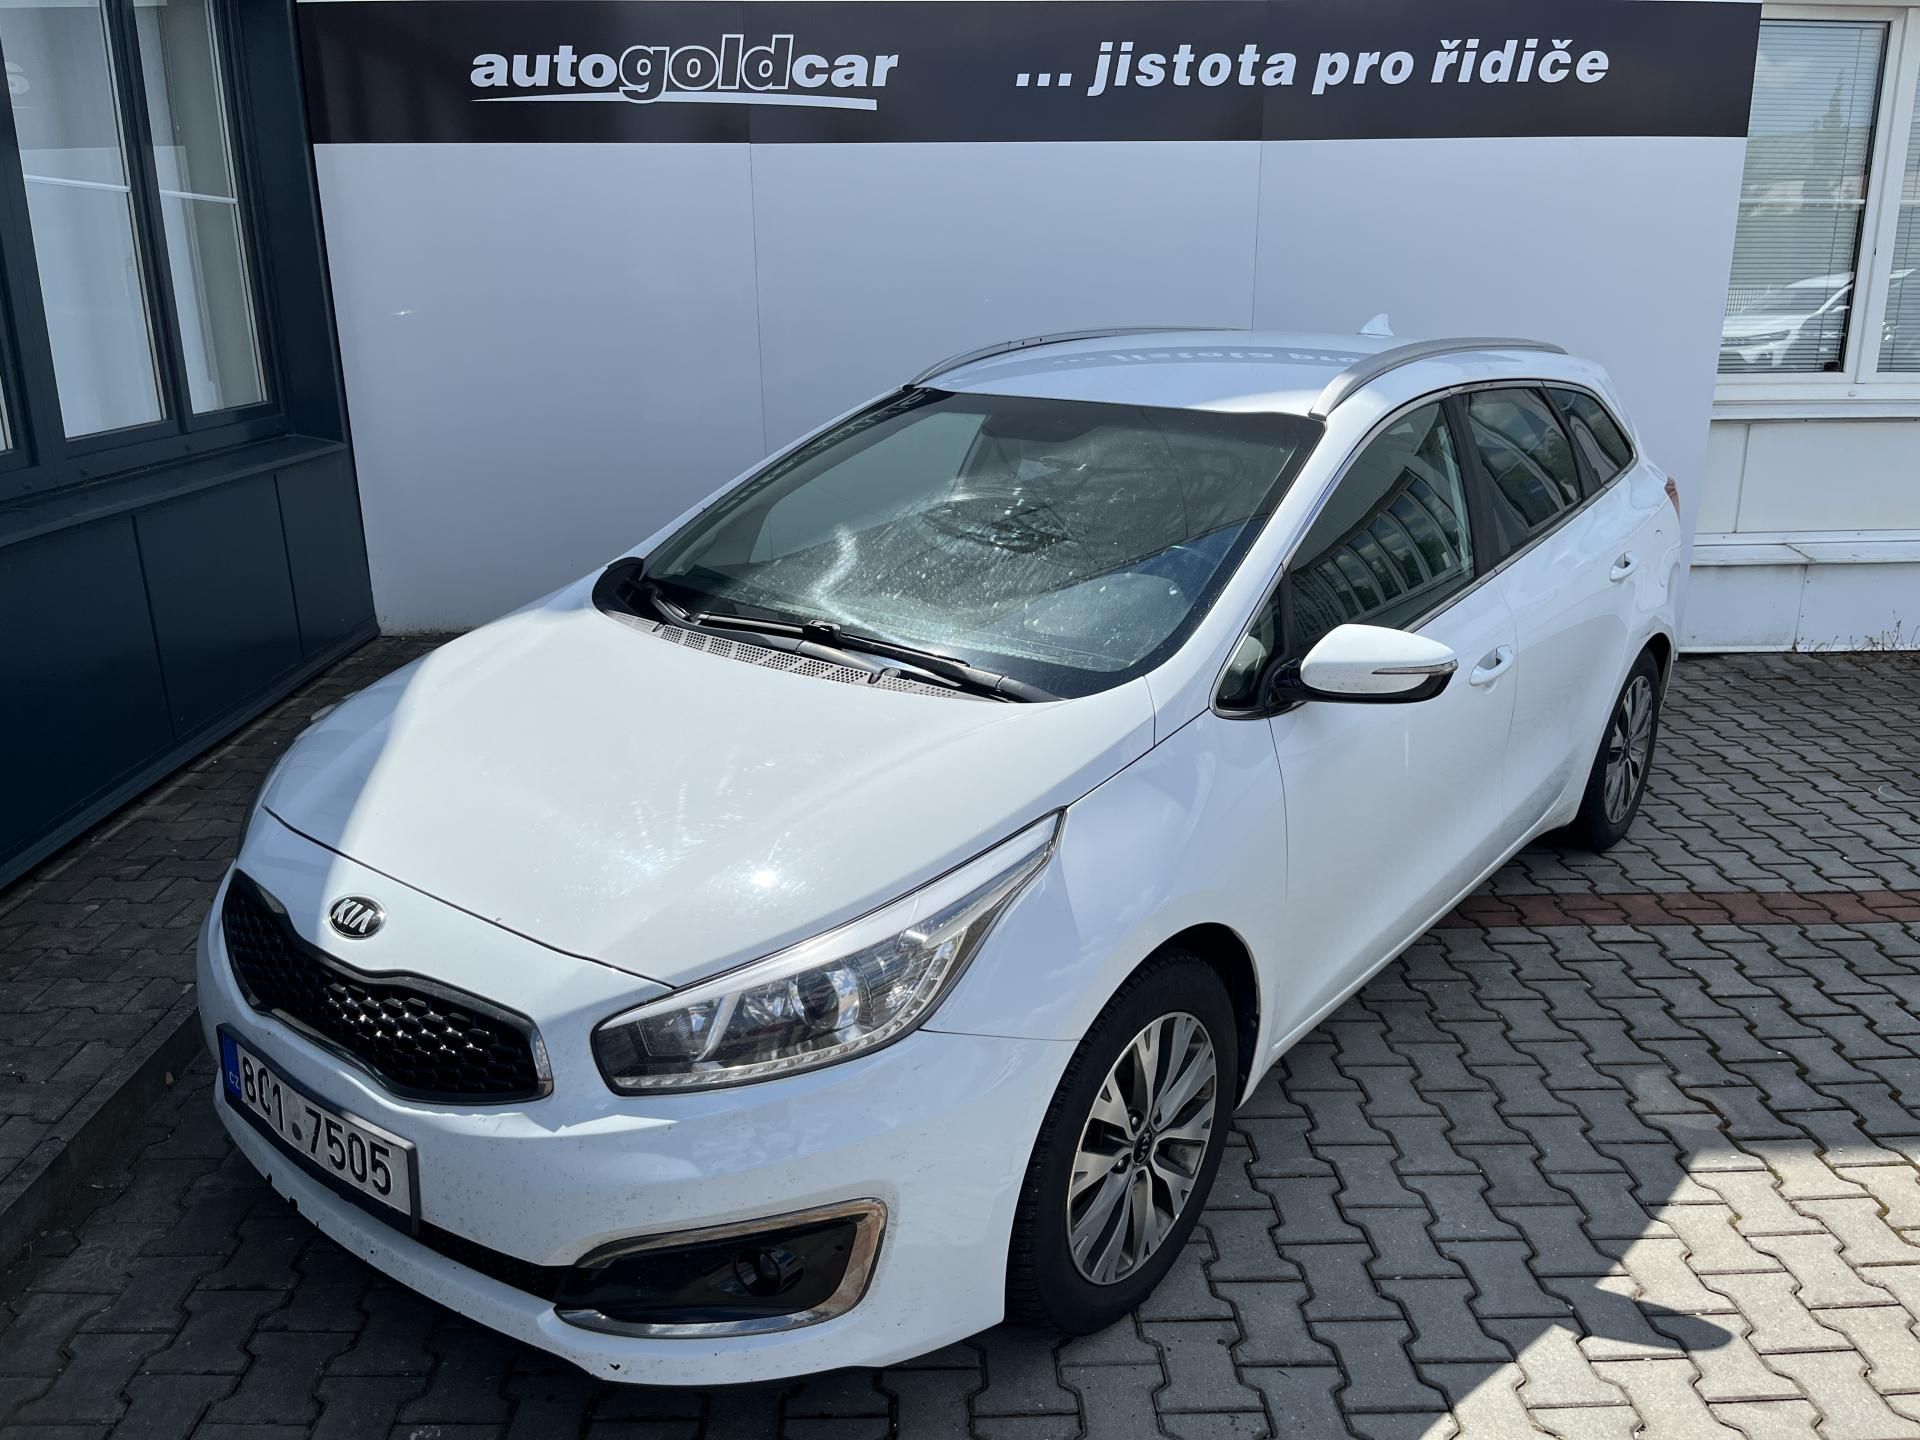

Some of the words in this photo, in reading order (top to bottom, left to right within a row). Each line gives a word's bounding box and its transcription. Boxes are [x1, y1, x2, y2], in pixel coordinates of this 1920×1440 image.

[471, 33, 899, 103] autogoldcar
[1087, 42, 1296, 96] jistota
[1312, 51, 1413, 94] pro
[1431, 39, 1608, 83] řidiče
[332, 899, 375, 933] KIA
[229, 1071, 241, 1090] CZ
[242, 1056, 285, 1132] 8C1
[305, 1104, 393, 1196] 7505
